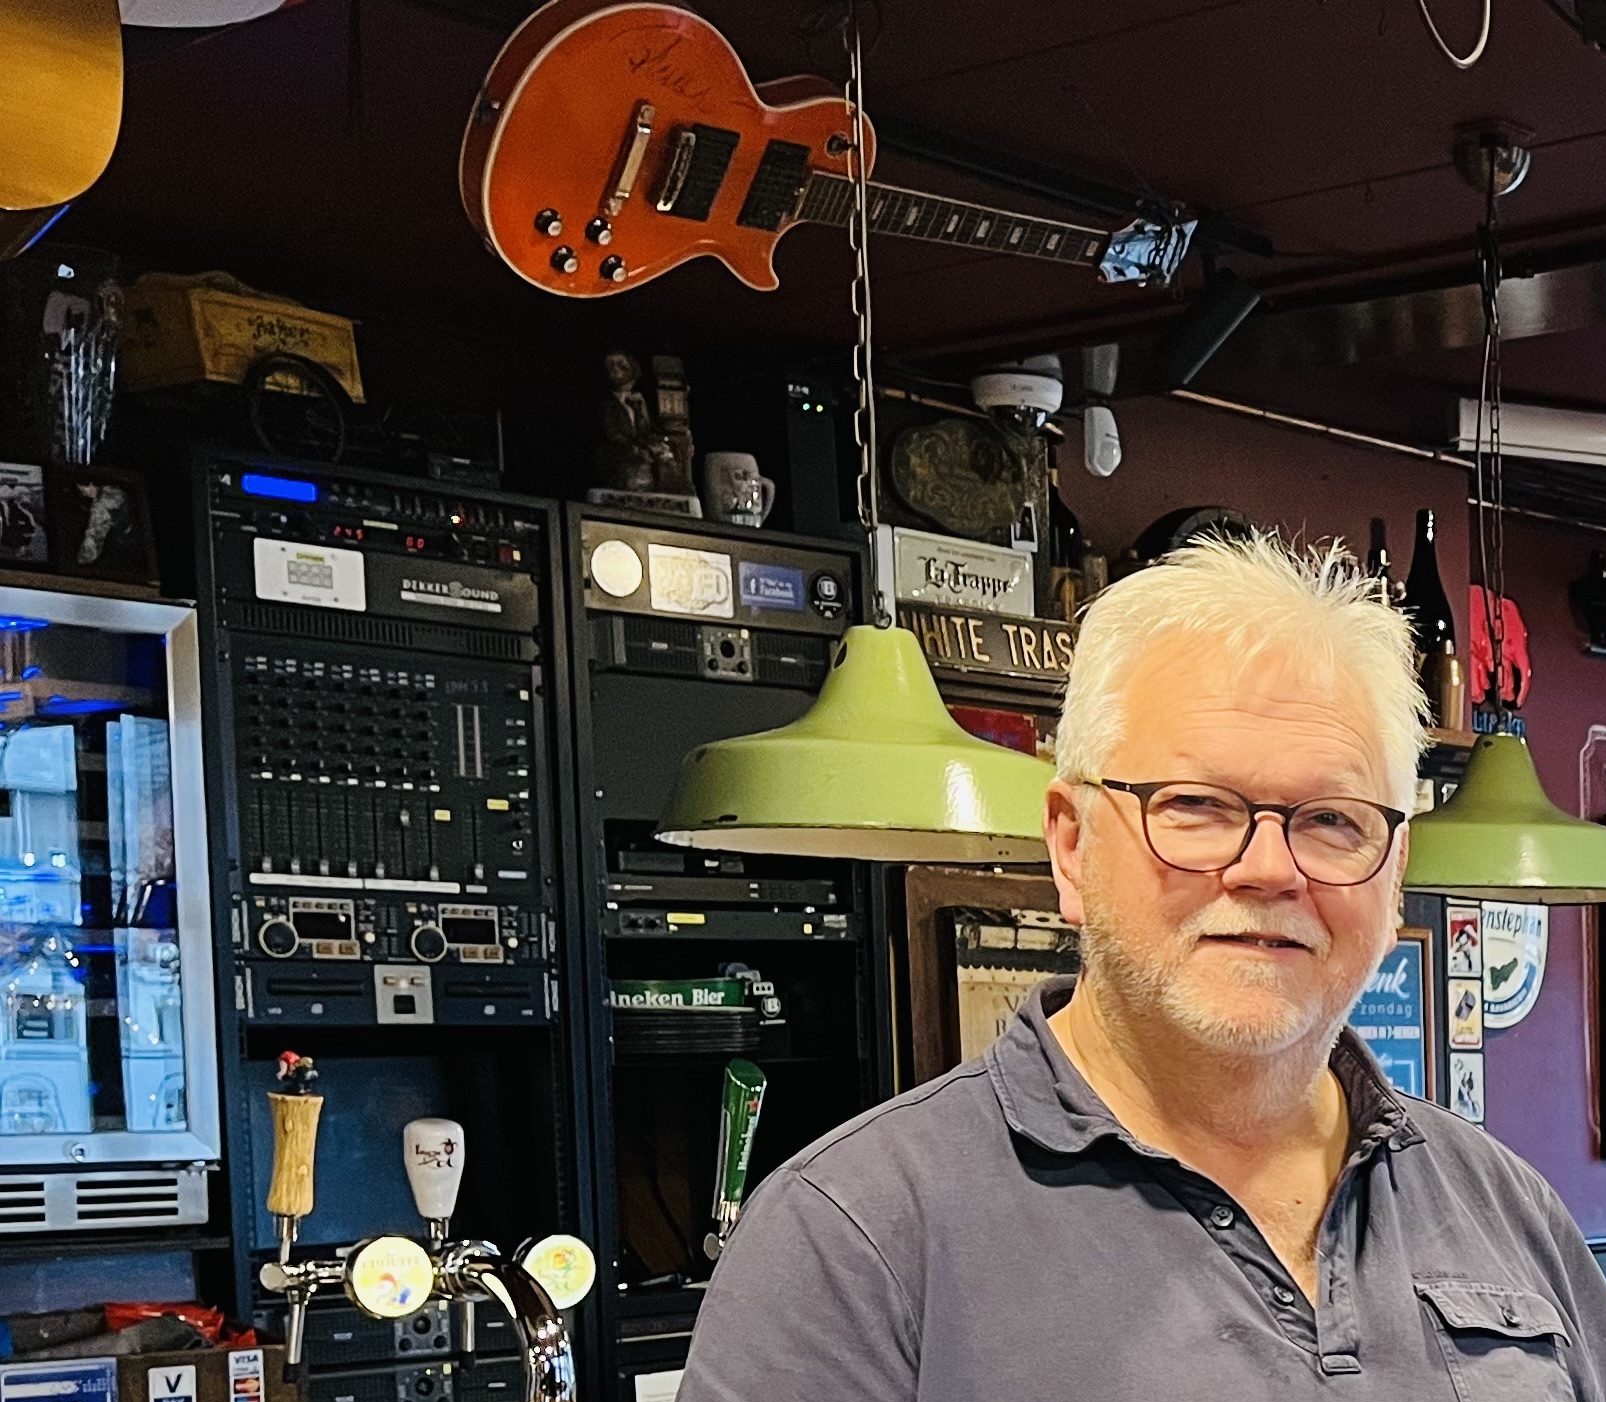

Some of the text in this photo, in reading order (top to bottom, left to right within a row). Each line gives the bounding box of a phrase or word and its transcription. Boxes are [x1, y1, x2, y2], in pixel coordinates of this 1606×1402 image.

[1002, 624, 1077, 671] TRAS
[610, 988, 725, 1006] ineken Bier
[233, 1354, 259, 1366] VISA
[164, 1373, 182, 1393] V
